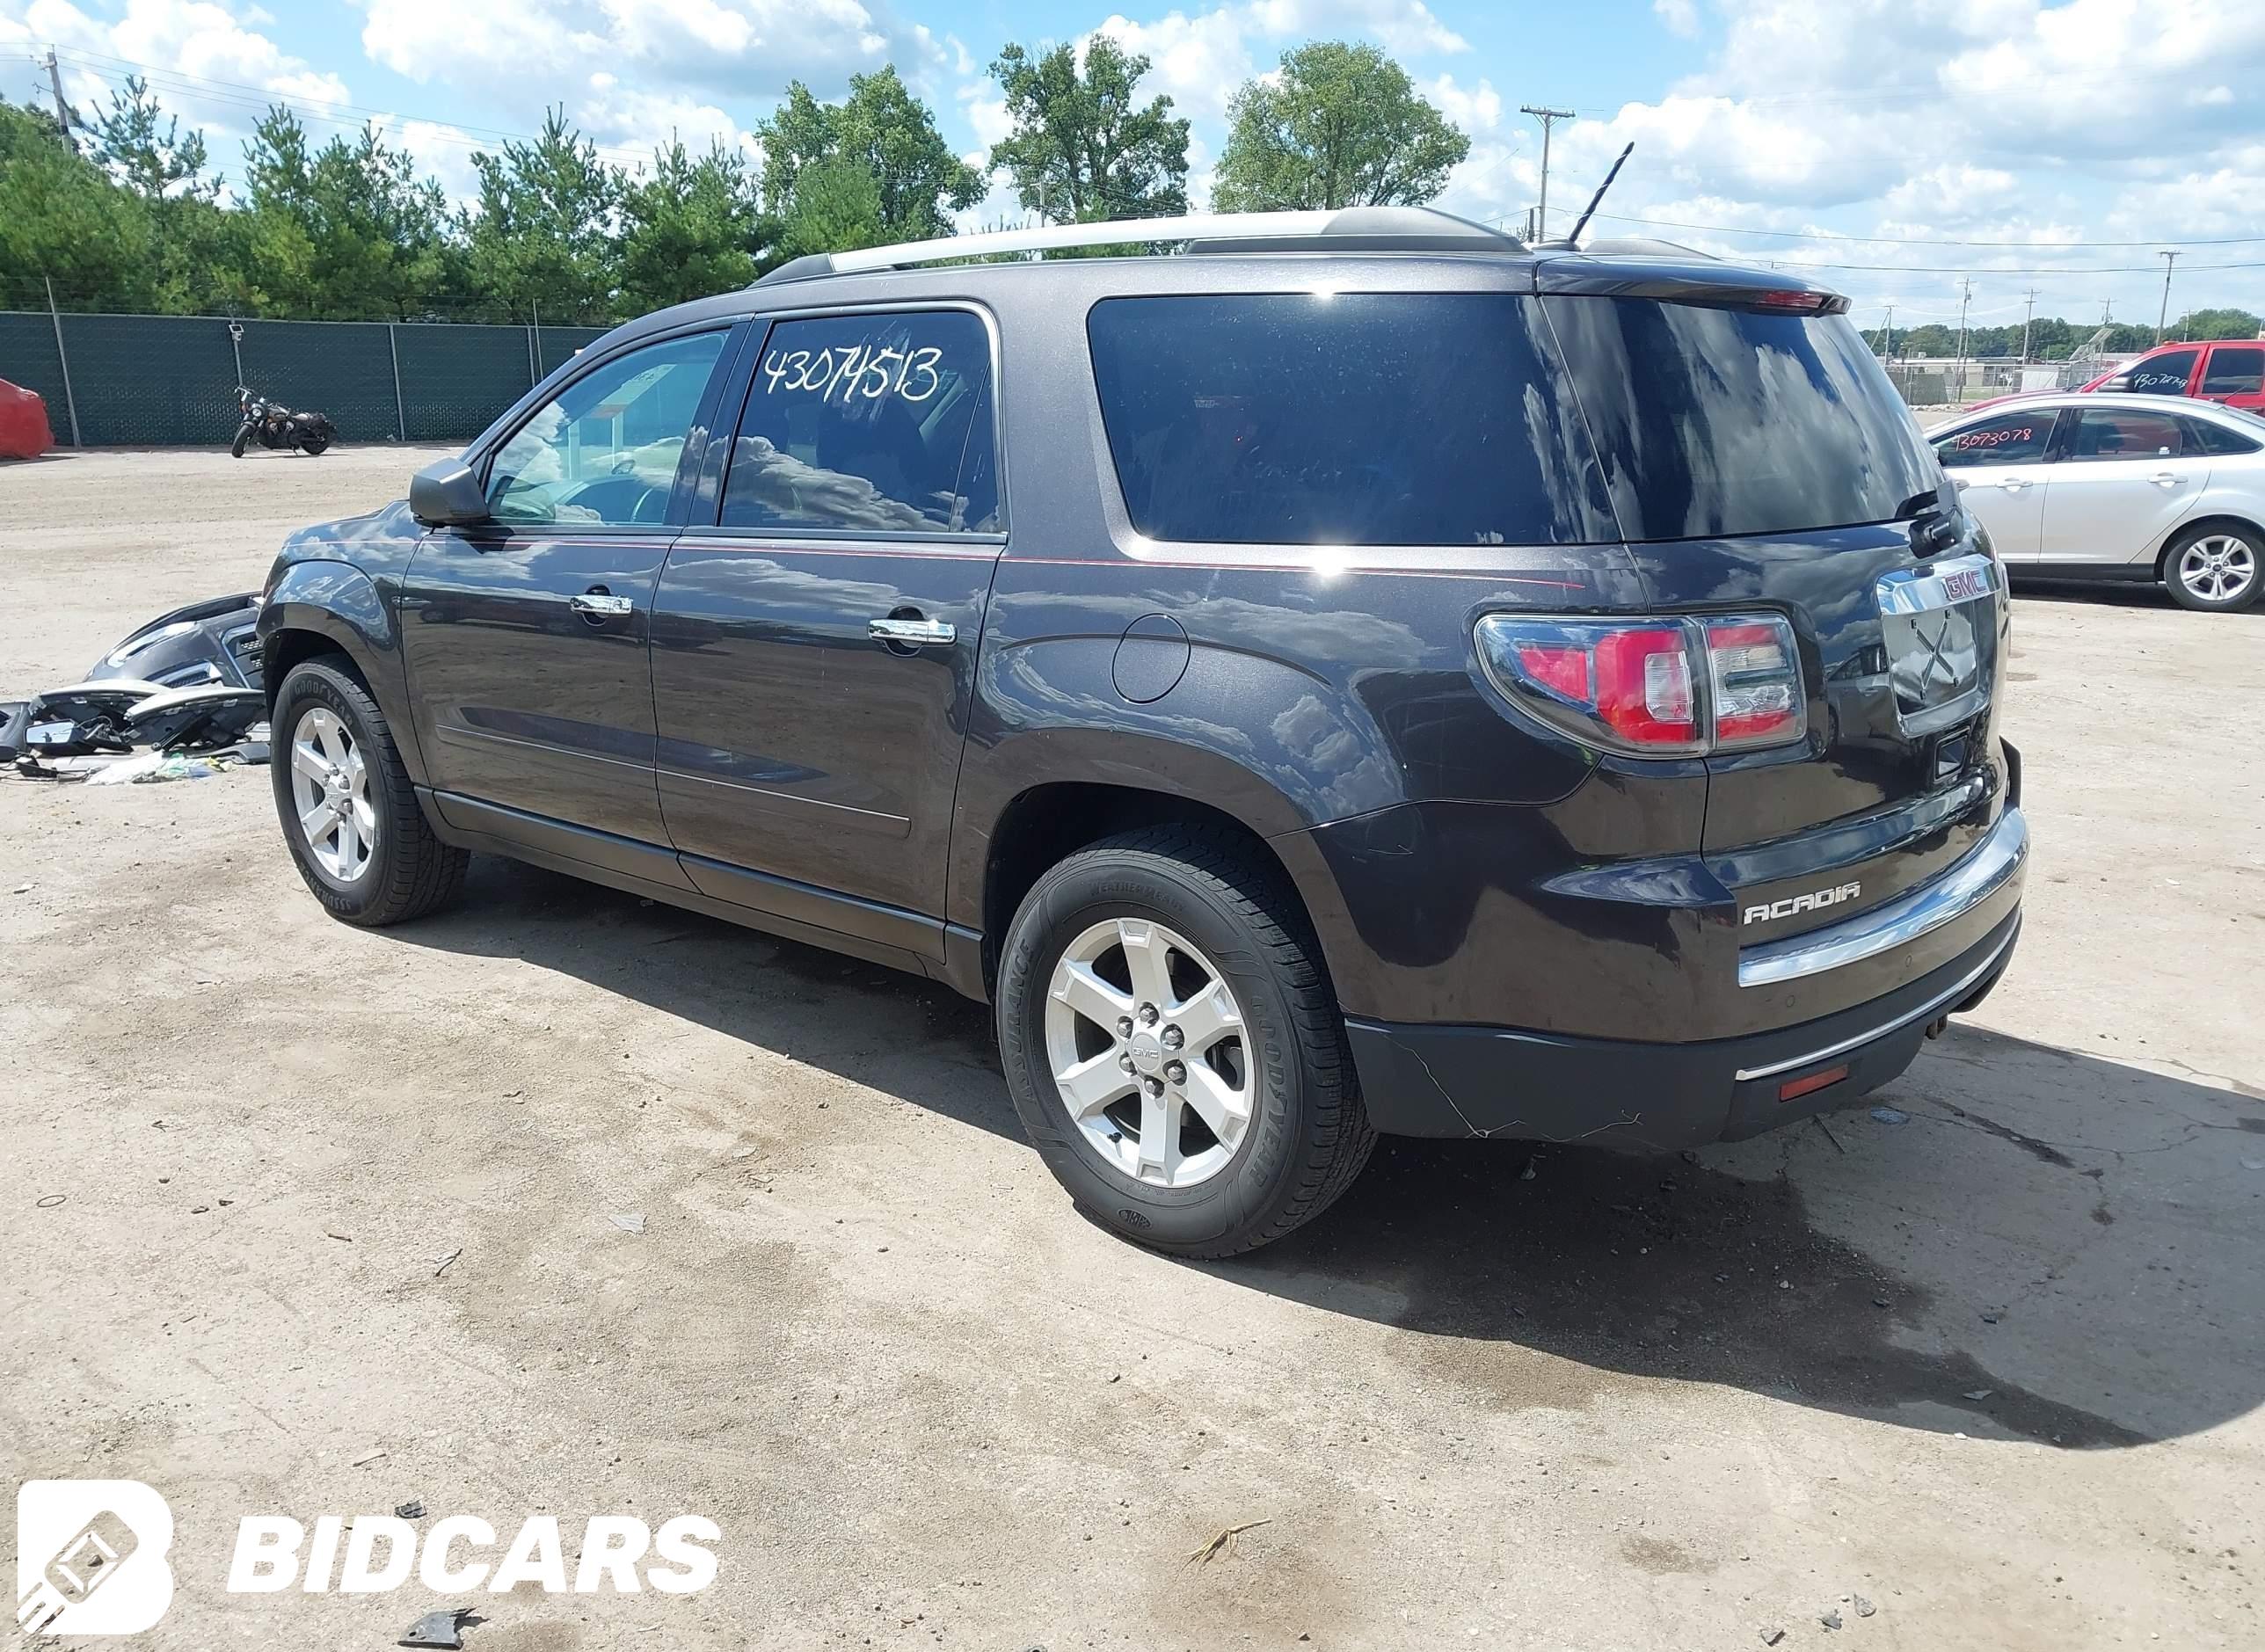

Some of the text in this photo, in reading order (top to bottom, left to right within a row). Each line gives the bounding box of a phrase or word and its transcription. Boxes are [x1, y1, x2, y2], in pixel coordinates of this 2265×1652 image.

[765, 344, 943, 402] 43074513
[1952, 428, 2032, 452] 43073078
[1942, 571, 1989, 600] GMC
[1743, 881, 1861, 926] ACADIA
[1007, 937, 1036, 1105] ASSURANCE
[1132, 1047, 1159, 1059] GMC
